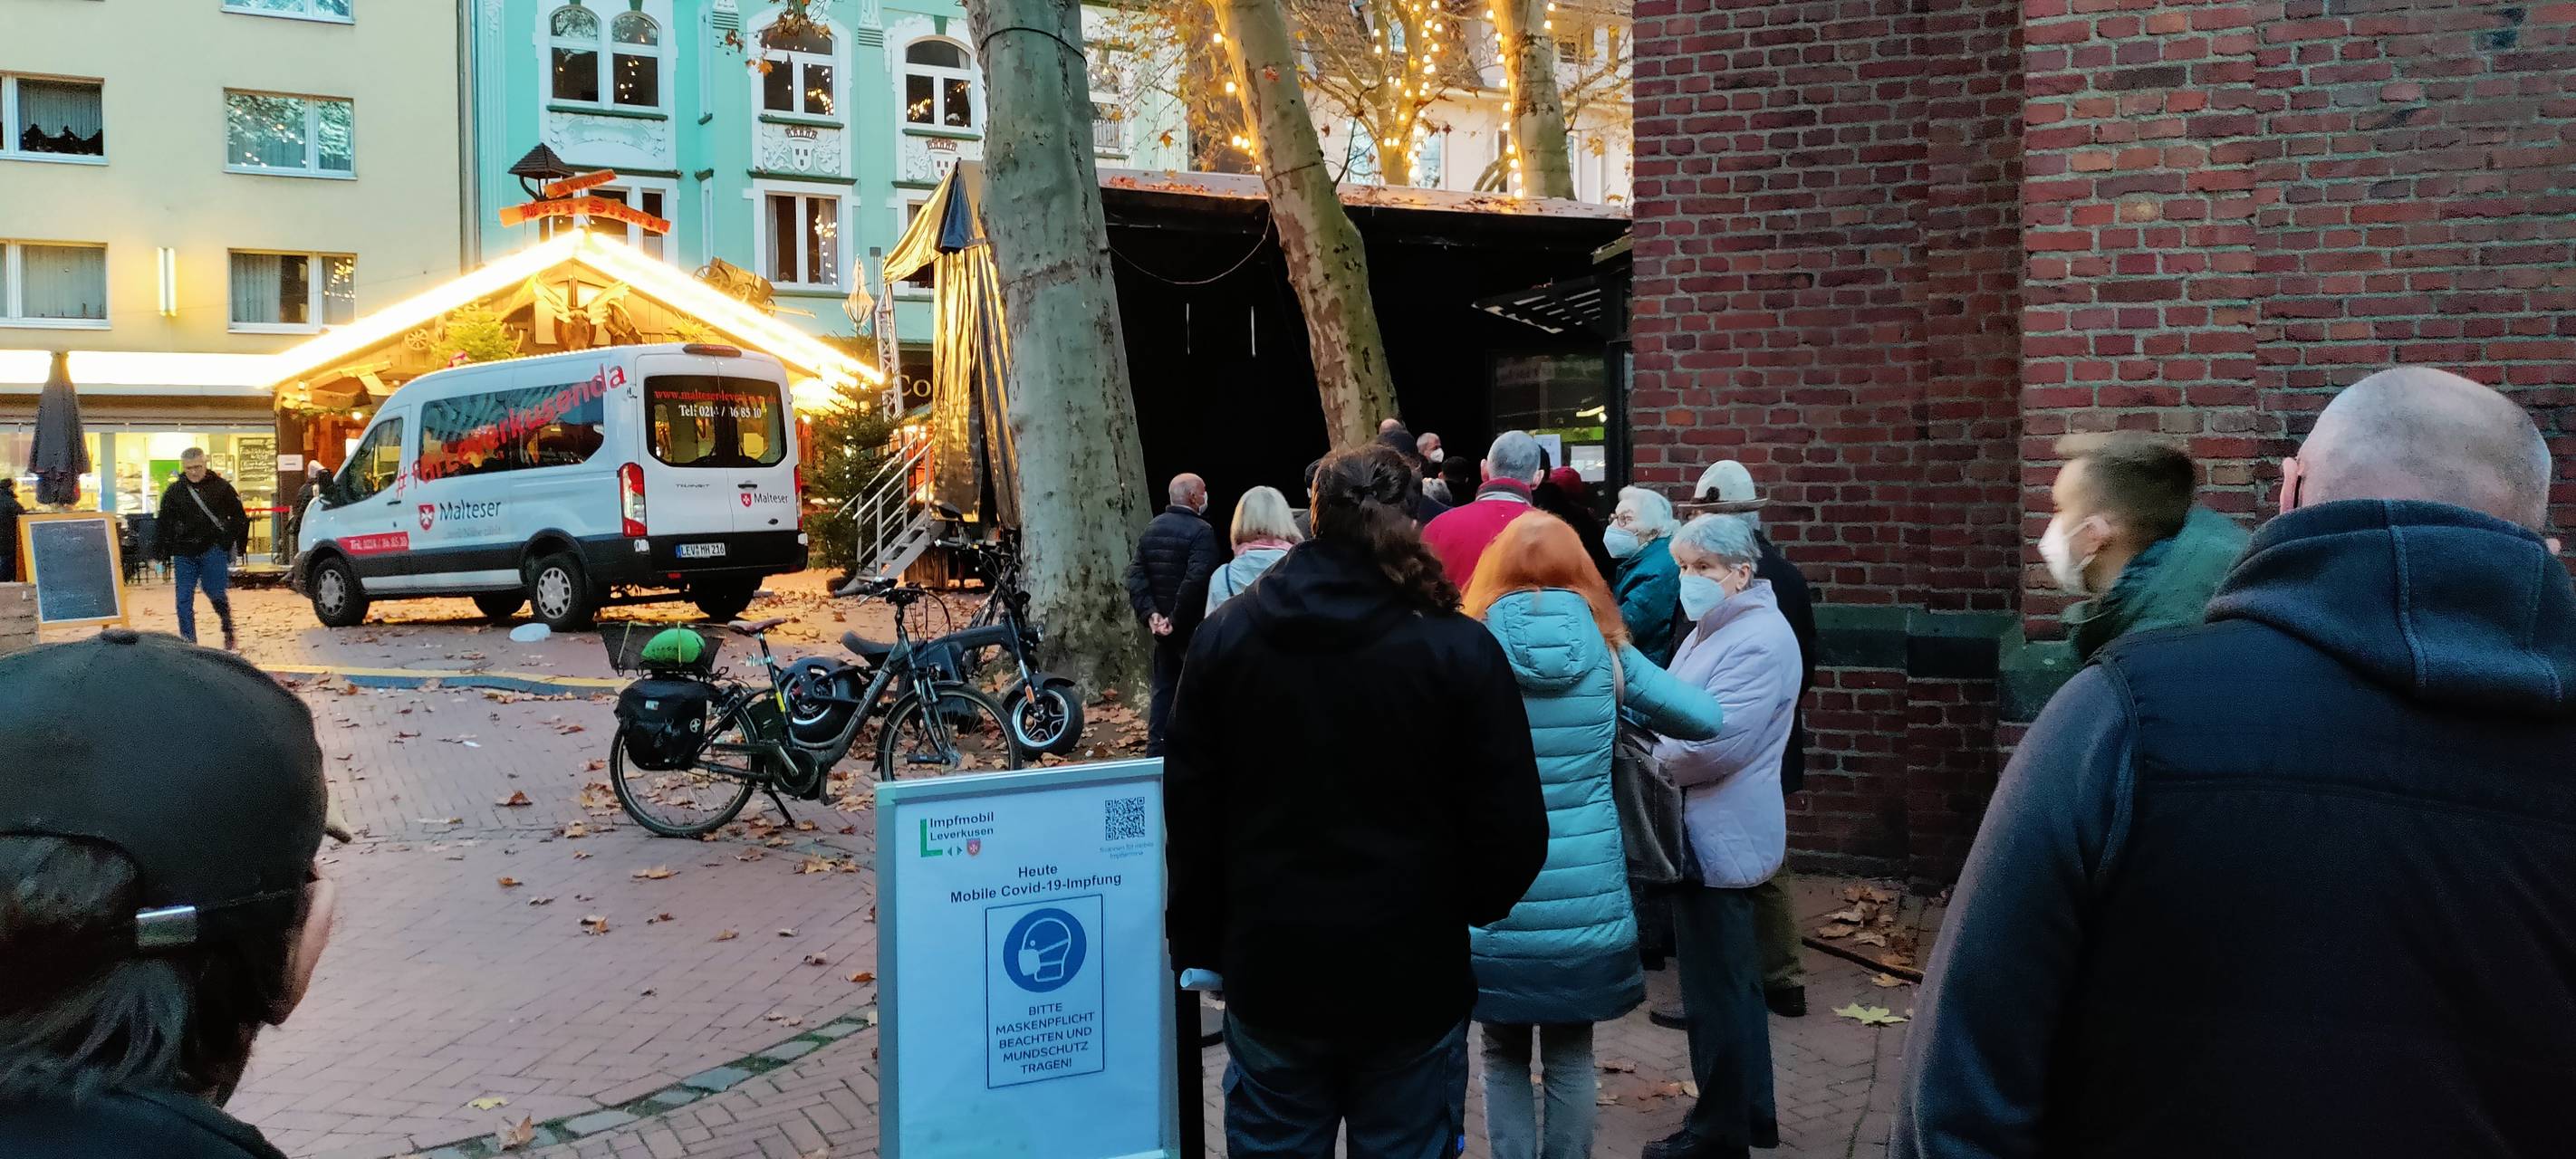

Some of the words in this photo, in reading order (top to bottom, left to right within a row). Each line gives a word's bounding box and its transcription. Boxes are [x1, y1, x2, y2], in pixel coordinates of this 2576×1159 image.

[754, 493, 789, 504] Malteser
[439, 499, 502, 522] Malteser
[681, 544, 696, 557] LEV
[712, 542, 725, 555] 216
[930, 811, 994, 829] Impfmobil
[930, 828, 994, 841] Leverkusen
[1018, 864, 1058, 878] Heute
[951, 886, 996, 903] Mobile
[1001, 874, 1122, 897] Covid-19-Impfung
[1028, 1002, 1062, 1016] BITTE
[995, 1011, 1095, 1036] MASKENPFLICHT
[999, 1030, 1063, 1049] BEACHTEN
[1066, 1027, 1092, 1039] UND
[1003, 1040, 1089, 1062] MUNDSCHUTZ
[1021, 1058, 1072, 1075] TRAGEN!
